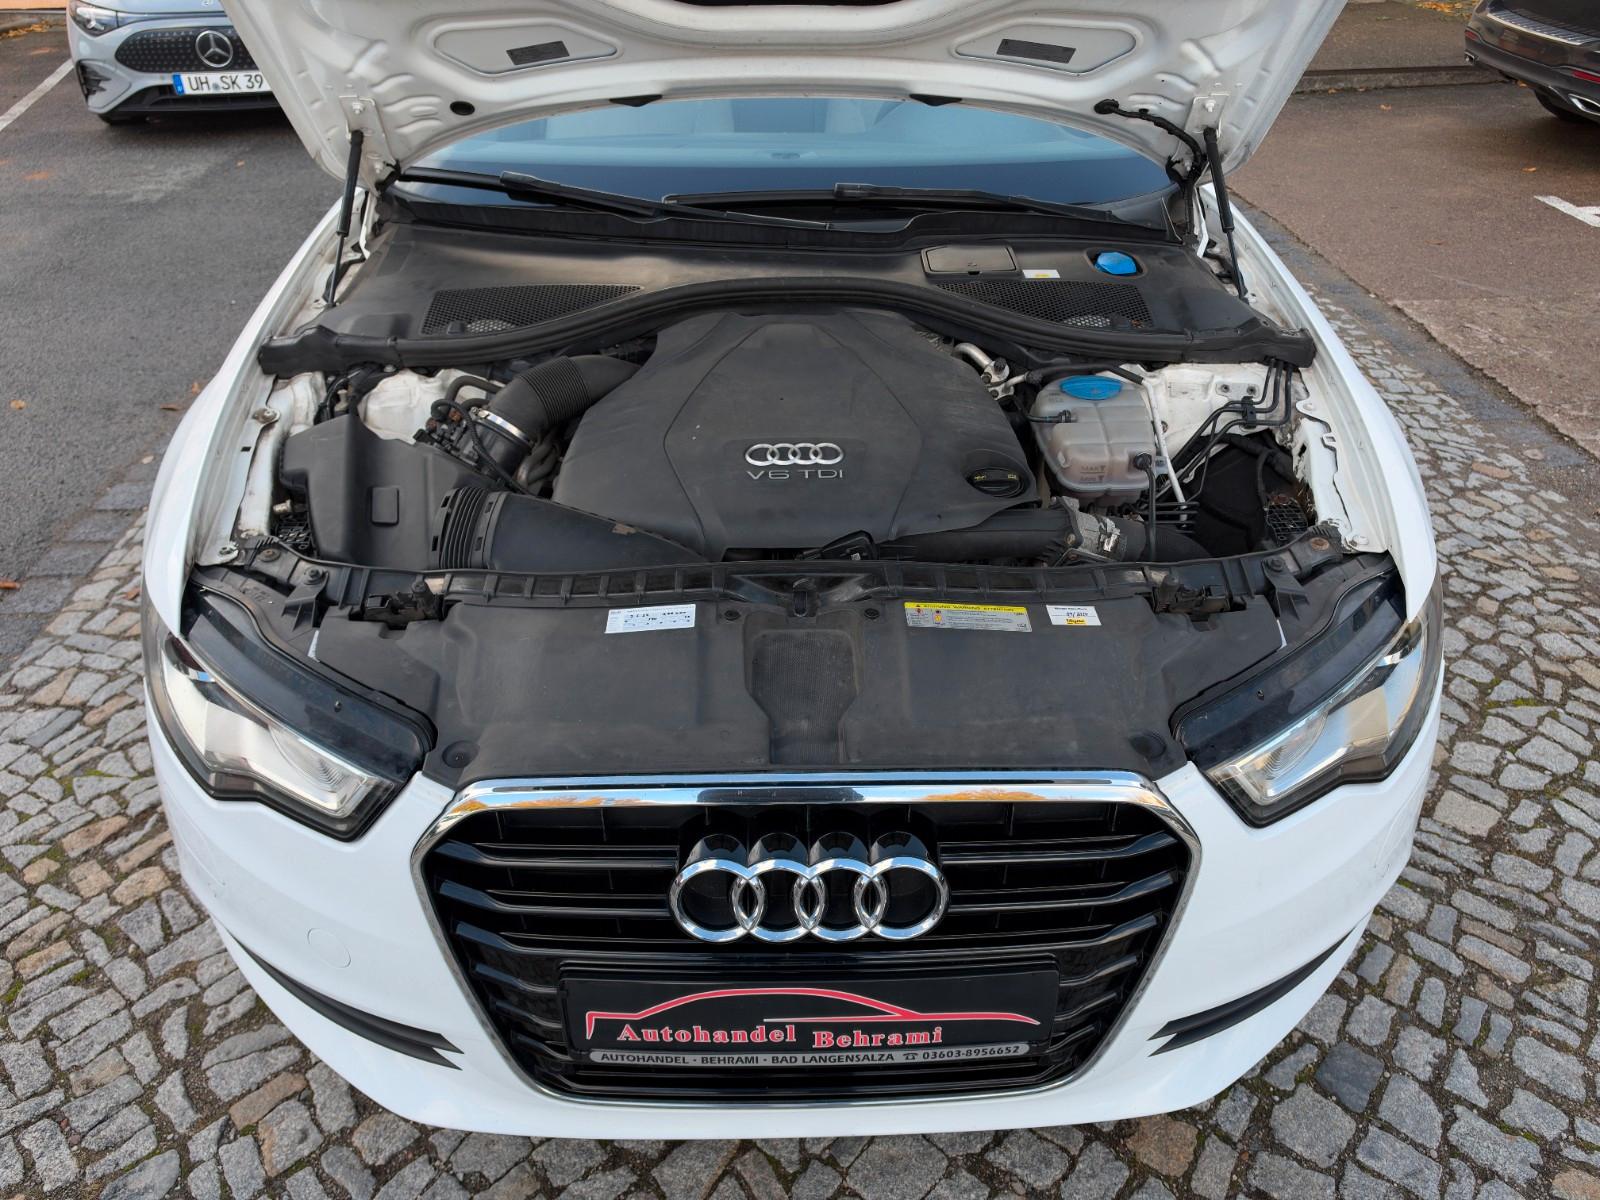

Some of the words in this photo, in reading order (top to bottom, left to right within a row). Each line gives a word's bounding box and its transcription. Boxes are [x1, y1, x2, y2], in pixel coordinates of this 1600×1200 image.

[187, 76, 210, 91] UH
[220, 75, 241, 90] SK
[244, 73, 263, 89] 39
[746, 469, 790, 479] V6
[797, 469, 843, 479] TDI
[616, 1023, 796, 1043] Autohandel
[812, 1026, 943, 1048] Behrami
[600, 1052, 689, 1065] AUTOHANDEL
[701, 1055, 759, 1065] BEHRAMI
[771, 1055, 798, 1065] BAD
[802, 1052, 895, 1065] LANGENSALZA
[922, 1045, 1020, 1060] 03603-8956652
